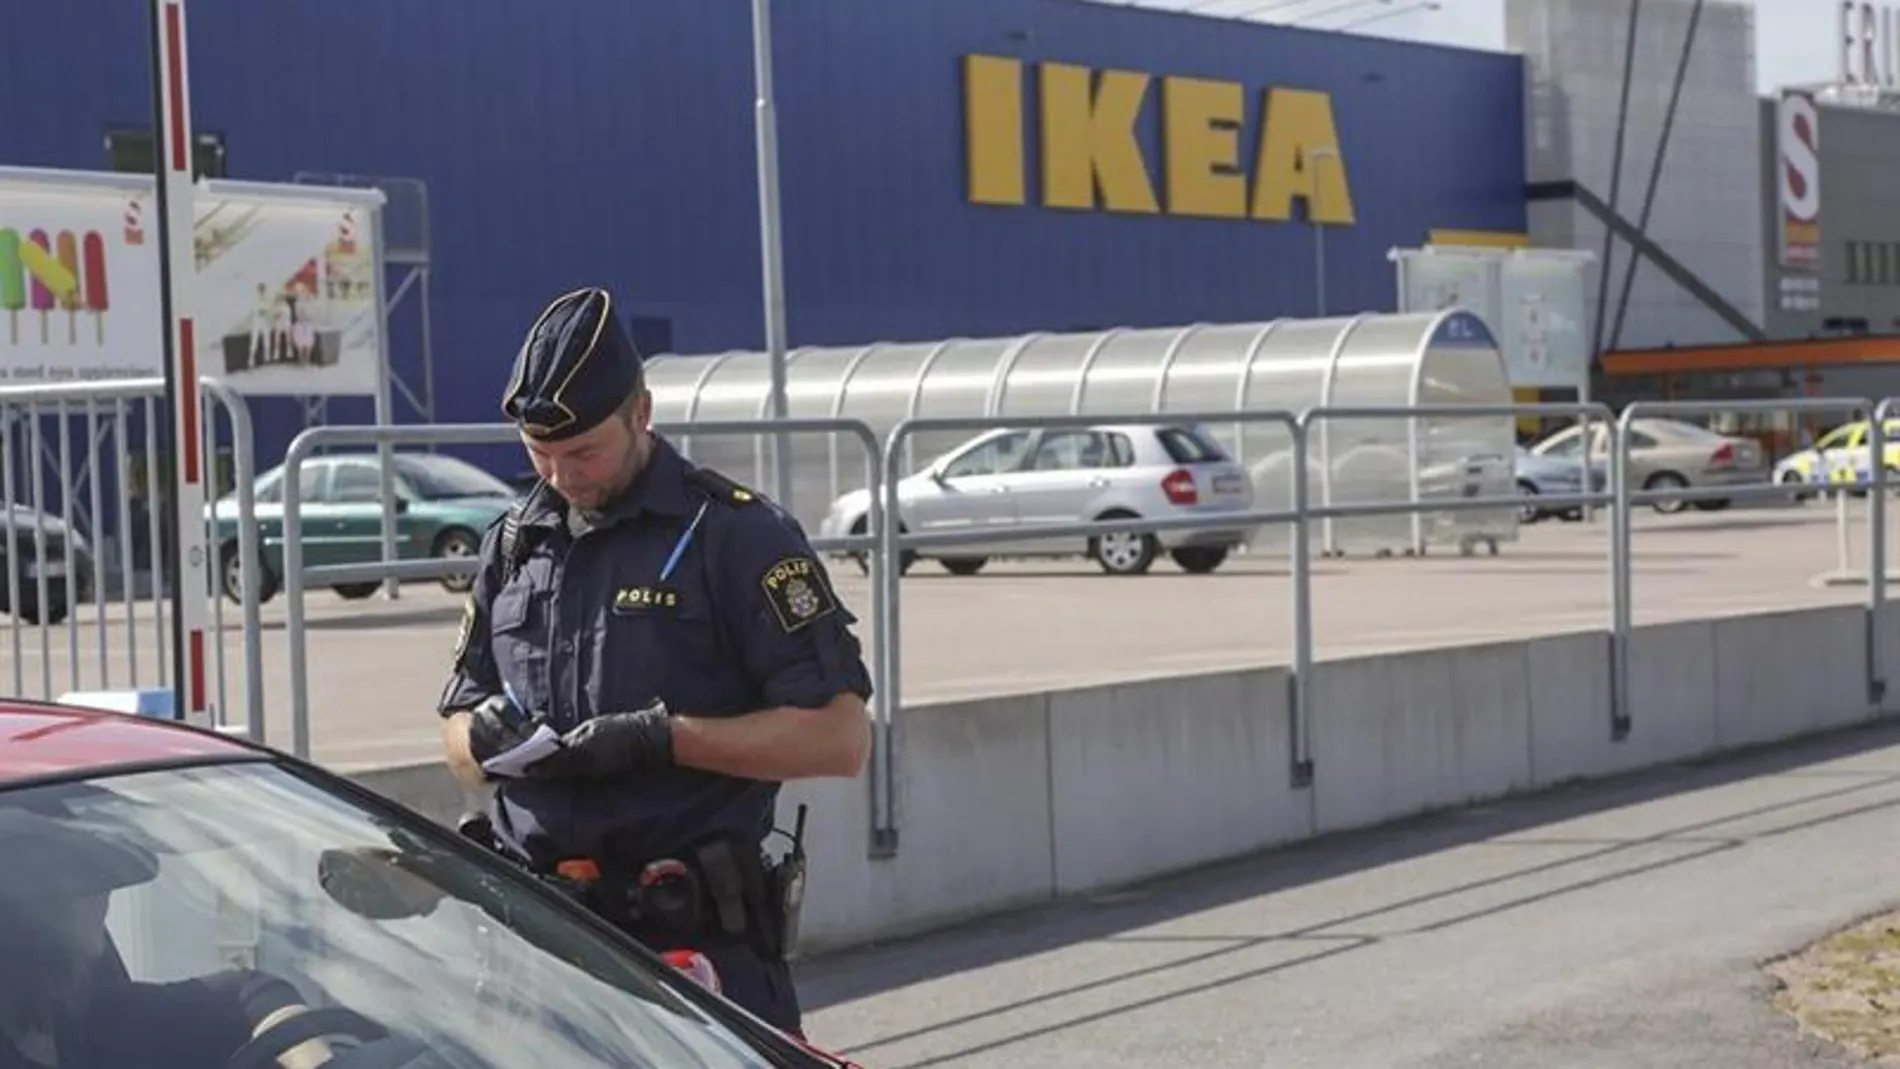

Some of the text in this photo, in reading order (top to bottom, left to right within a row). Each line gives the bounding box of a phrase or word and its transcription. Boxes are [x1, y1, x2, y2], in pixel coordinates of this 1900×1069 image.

[964, 53, 1357, 224] IKEA
[767, 560, 811, 590] POLIS
[616, 588, 677, 606] POLIS
